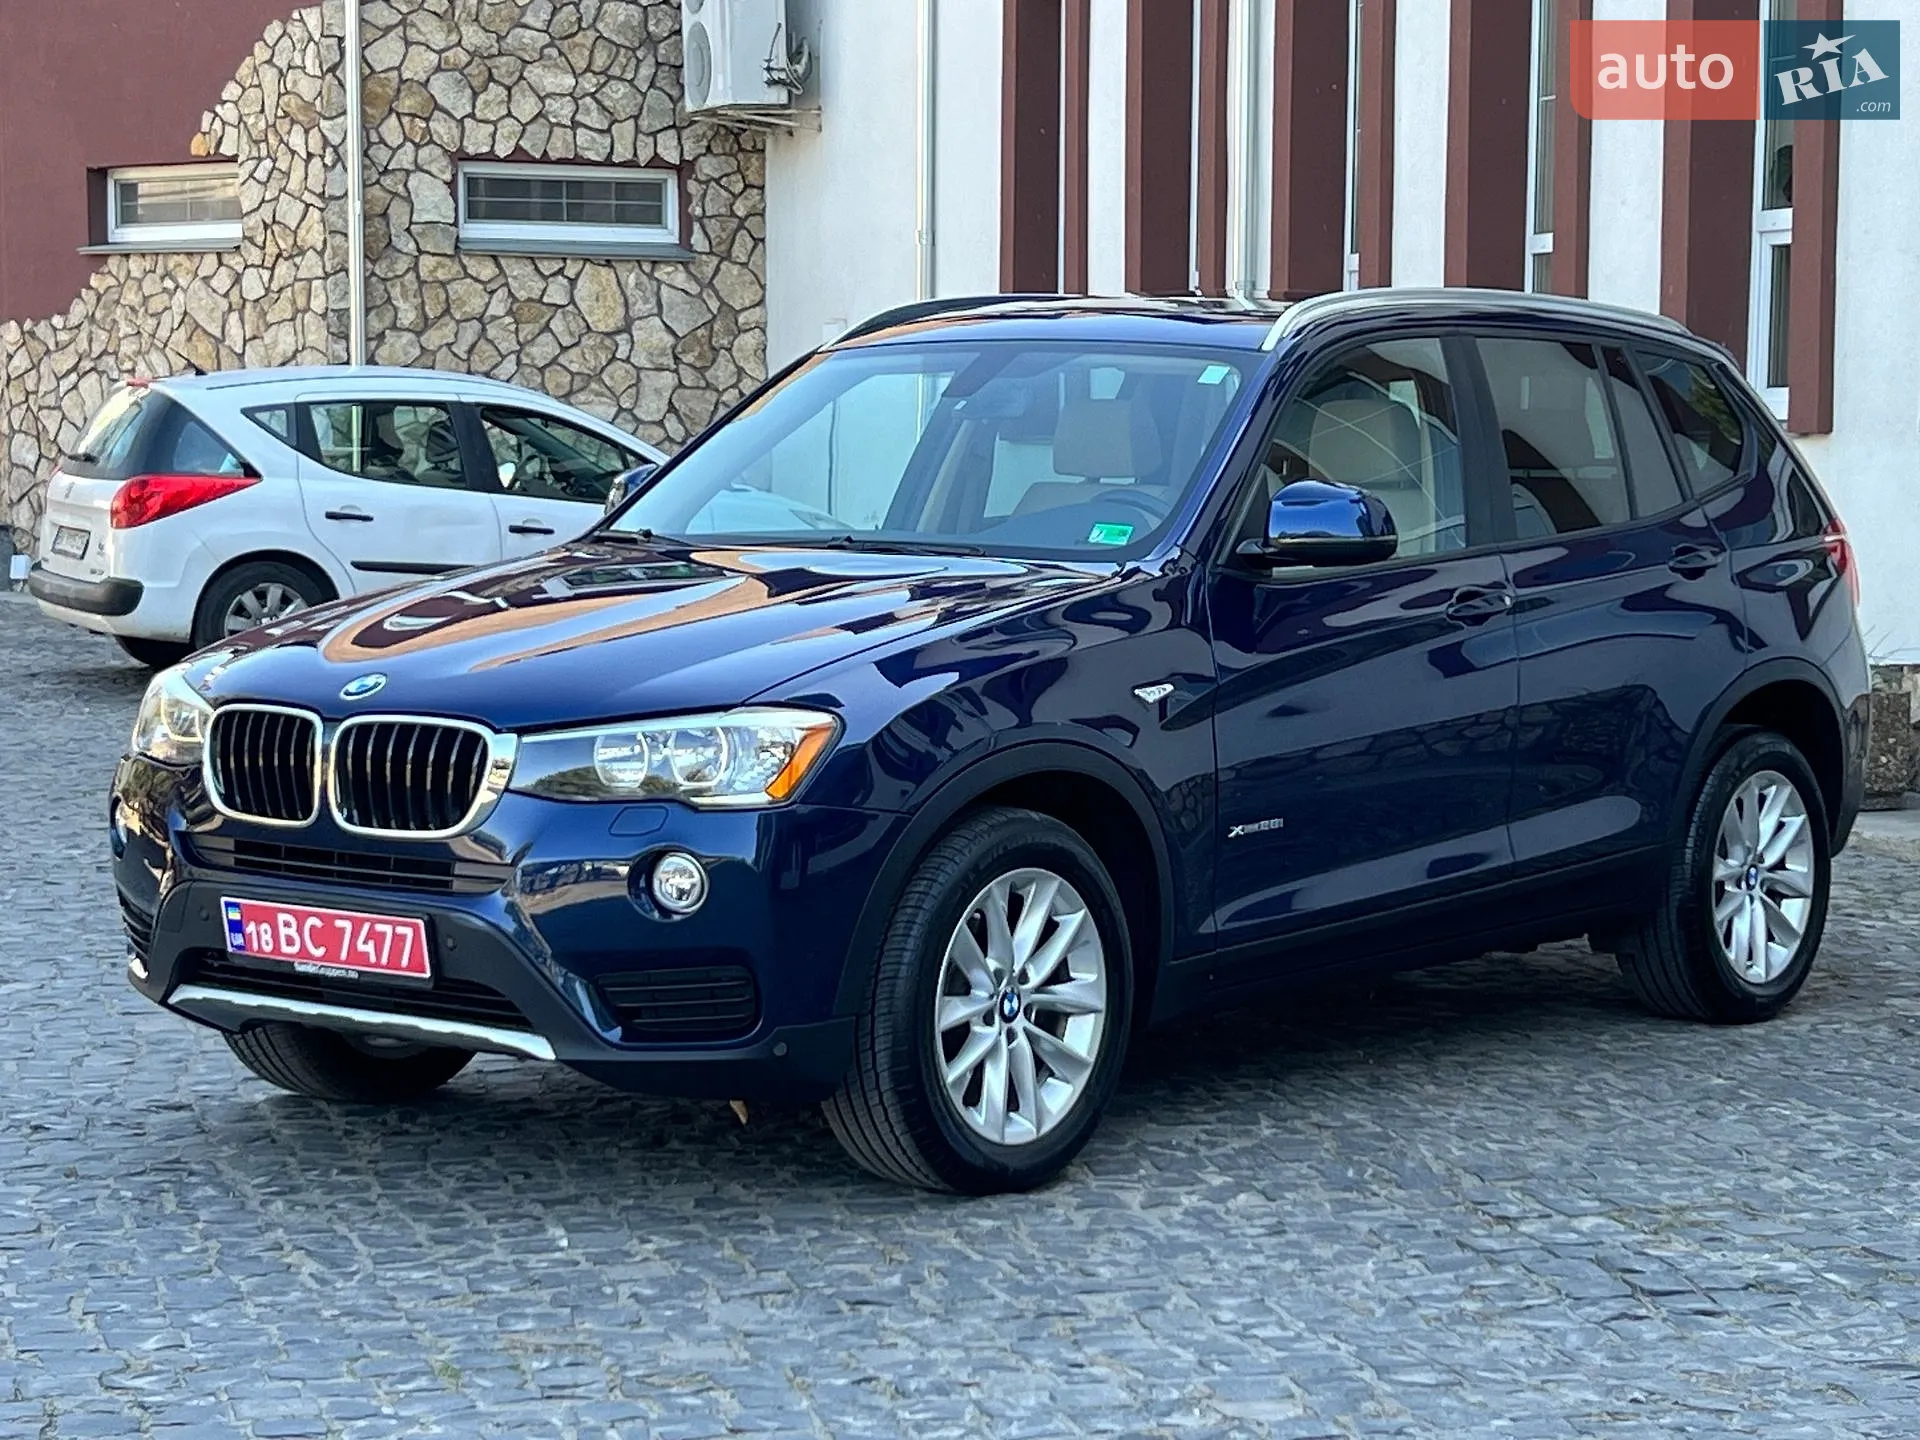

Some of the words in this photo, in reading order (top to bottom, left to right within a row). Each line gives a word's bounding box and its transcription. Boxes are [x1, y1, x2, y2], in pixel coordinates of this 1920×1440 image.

[246, 920, 274, 953] 18
[276, 912, 327, 958] BC
[334, 919, 414, 968] 7477
